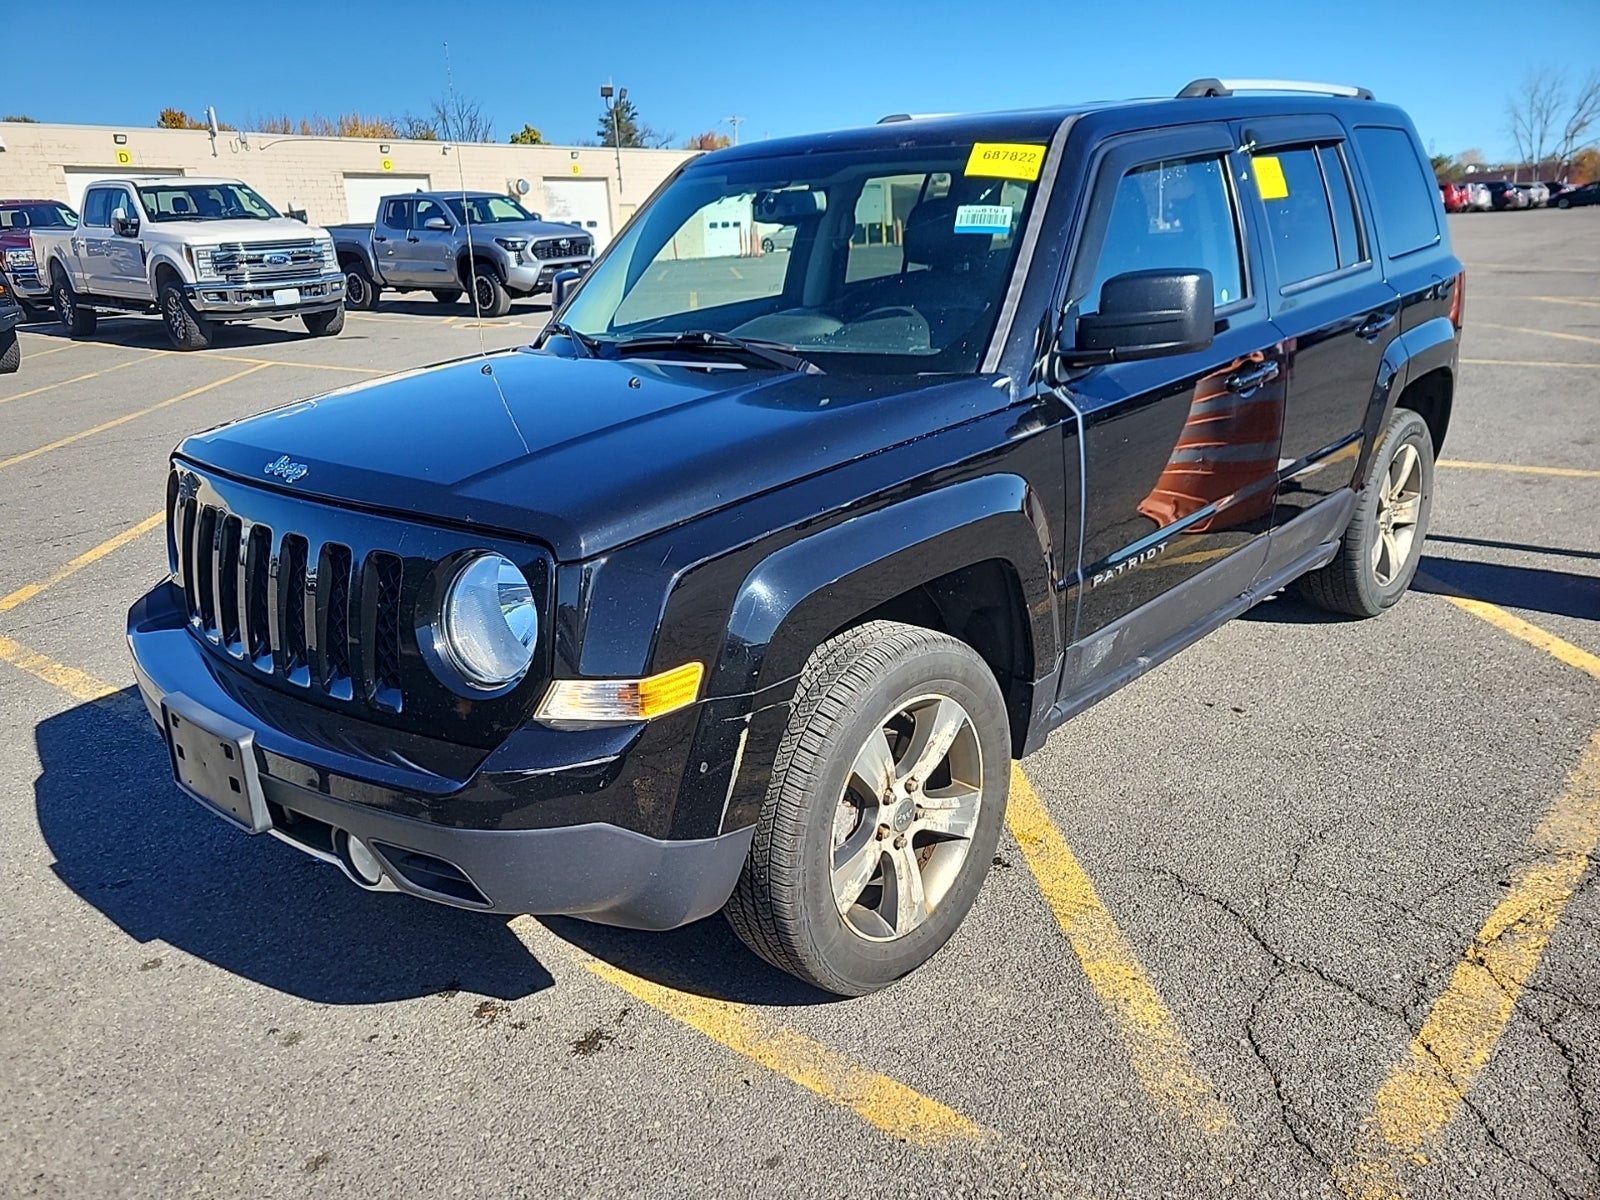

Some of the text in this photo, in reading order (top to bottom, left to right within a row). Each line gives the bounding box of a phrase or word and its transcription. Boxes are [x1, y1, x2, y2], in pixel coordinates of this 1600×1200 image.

[119, 153, 129, 163] D
[983, 150, 1037, 163] 687822
[383, 160, 391, 170] C
[572, 165, 579, 174] B
[264, 455, 308, 483] Jeep
[1091, 541, 1168, 588] PATRIOT
